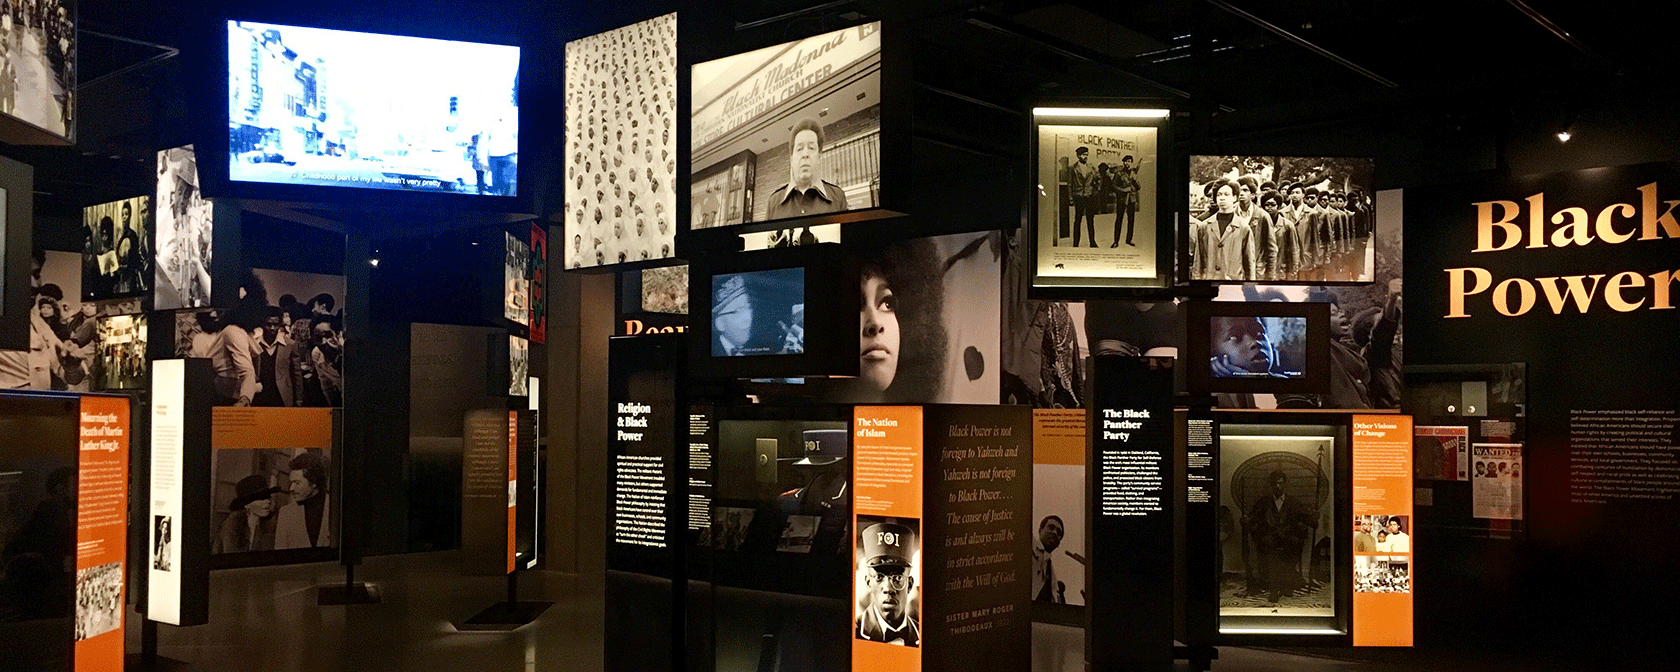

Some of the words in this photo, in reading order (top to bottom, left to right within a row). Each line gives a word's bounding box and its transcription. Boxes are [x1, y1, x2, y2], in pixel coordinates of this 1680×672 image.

[722, 78, 764, 117] Black
[764, 31, 847, 90] Madonna
[768, 69, 803, 95] CHURCH
[728, 95, 776, 132] CULTURAL
[780, 63, 833, 102] CENTER
[1078, 134, 1103, 146] BLACK
[422, 180, 442, 188] pretty
[1471, 182, 1680, 252] Black
[1444, 267, 1680, 318] Power
[618, 402, 651, 416] Religion
[1102, 409, 1122, 418] The
[1123, 409, 1150, 418] Black
[81, 412, 108, 426] Mourning
[109, 413, 117, 422] the
[616, 417, 624, 427] &
[625, 416, 648, 428] Black
[857, 418, 872, 426] The
[872, 418, 898, 427] Nation
[1103, 420, 1142, 429] Panther
[80, 426, 97, 436] Death
[97, 426, 104, 436] of
[105, 426, 123, 436] Martin
[617, 430, 643, 441] Power
[856, 428, 866, 437] of
[866, 428, 886, 437] Islam
[949, 424, 968, 436] Black
[970, 425, 992, 437] Power
[993, 425, 999, 436] is
[1000, 426, 1012, 436] not
[1103, 431, 1130, 442] Party
[80, 440, 100, 450] Luther
[940, 447, 966, 462] foreign
[968, 448, 975, 458] to
[977, 446, 1003, 458] Yahweh
[1004, 445, 1019, 457] and
[943, 468, 970, 481] Yahweh
[972, 468, 978, 479] is
[979, 468, 991, 479] not
[990, 467, 1016, 482] foreign
[949, 493, 956, 503] to
[958, 489, 978, 502] Black
[946, 512, 961, 524] The
[962, 513, 982, 523] cause
[982, 509, 991, 524] of
[990, 508, 1013, 522] Justice
[877, 532, 900, 548] FOI
[945, 535, 951, 547] is
[952, 532, 968, 546] and
[968, 532, 993, 547] always
[993, 529, 1006, 542] will
[956, 554, 974, 568] strict
[975, 551, 1014, 565] accordance
[963, 576, 974, 588] the
[976, 572, 991, 586] Will
[946, 612, 969, 623] SISTER
[971, 608, 990, 618] MARY
[992, 604, 1014, 614] ROGER
[950, 621, 993, 635] THIBODEAUX
